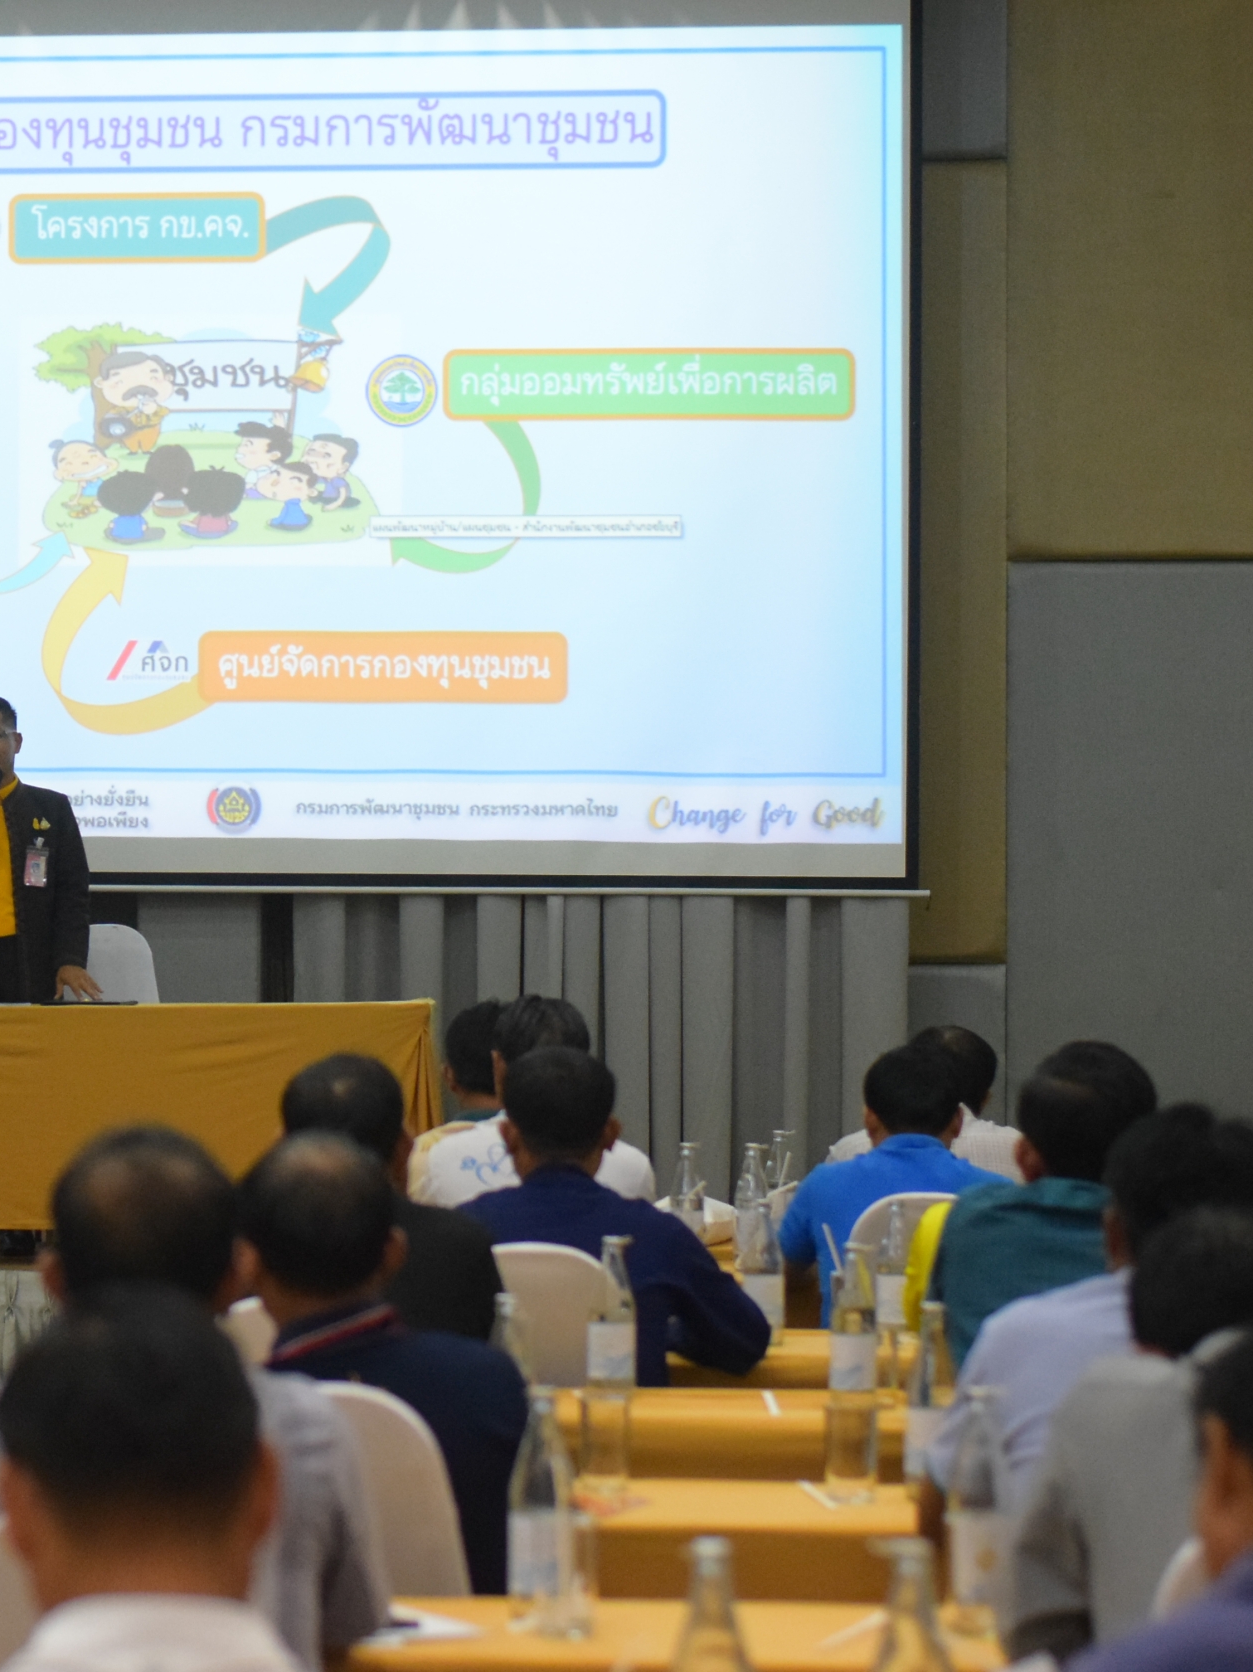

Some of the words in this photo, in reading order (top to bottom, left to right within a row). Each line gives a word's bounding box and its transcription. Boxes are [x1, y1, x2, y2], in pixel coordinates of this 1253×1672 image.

[240, 97, 656, 162] กรมการพัฒนาชุมชน
[31, 205, 150, 241] โครงการ
[459, 354, 839, 407] กลุ่มออมทรัพย์เพื่อการผลิต
[141, 654, 189, 673] ศจก
[218, 643, 551, 690] ศูนย์จัดการกองทุนชุมชน
[295, 798, 461, 821] กรมการพัฒนาชุมชน
[469, 797, 619, 819] กระทรวงมหาดไทย
[648, 795, 747, 834] Change
[758, 800, 797, 837] for
[812, 796, 886, 831] Good
